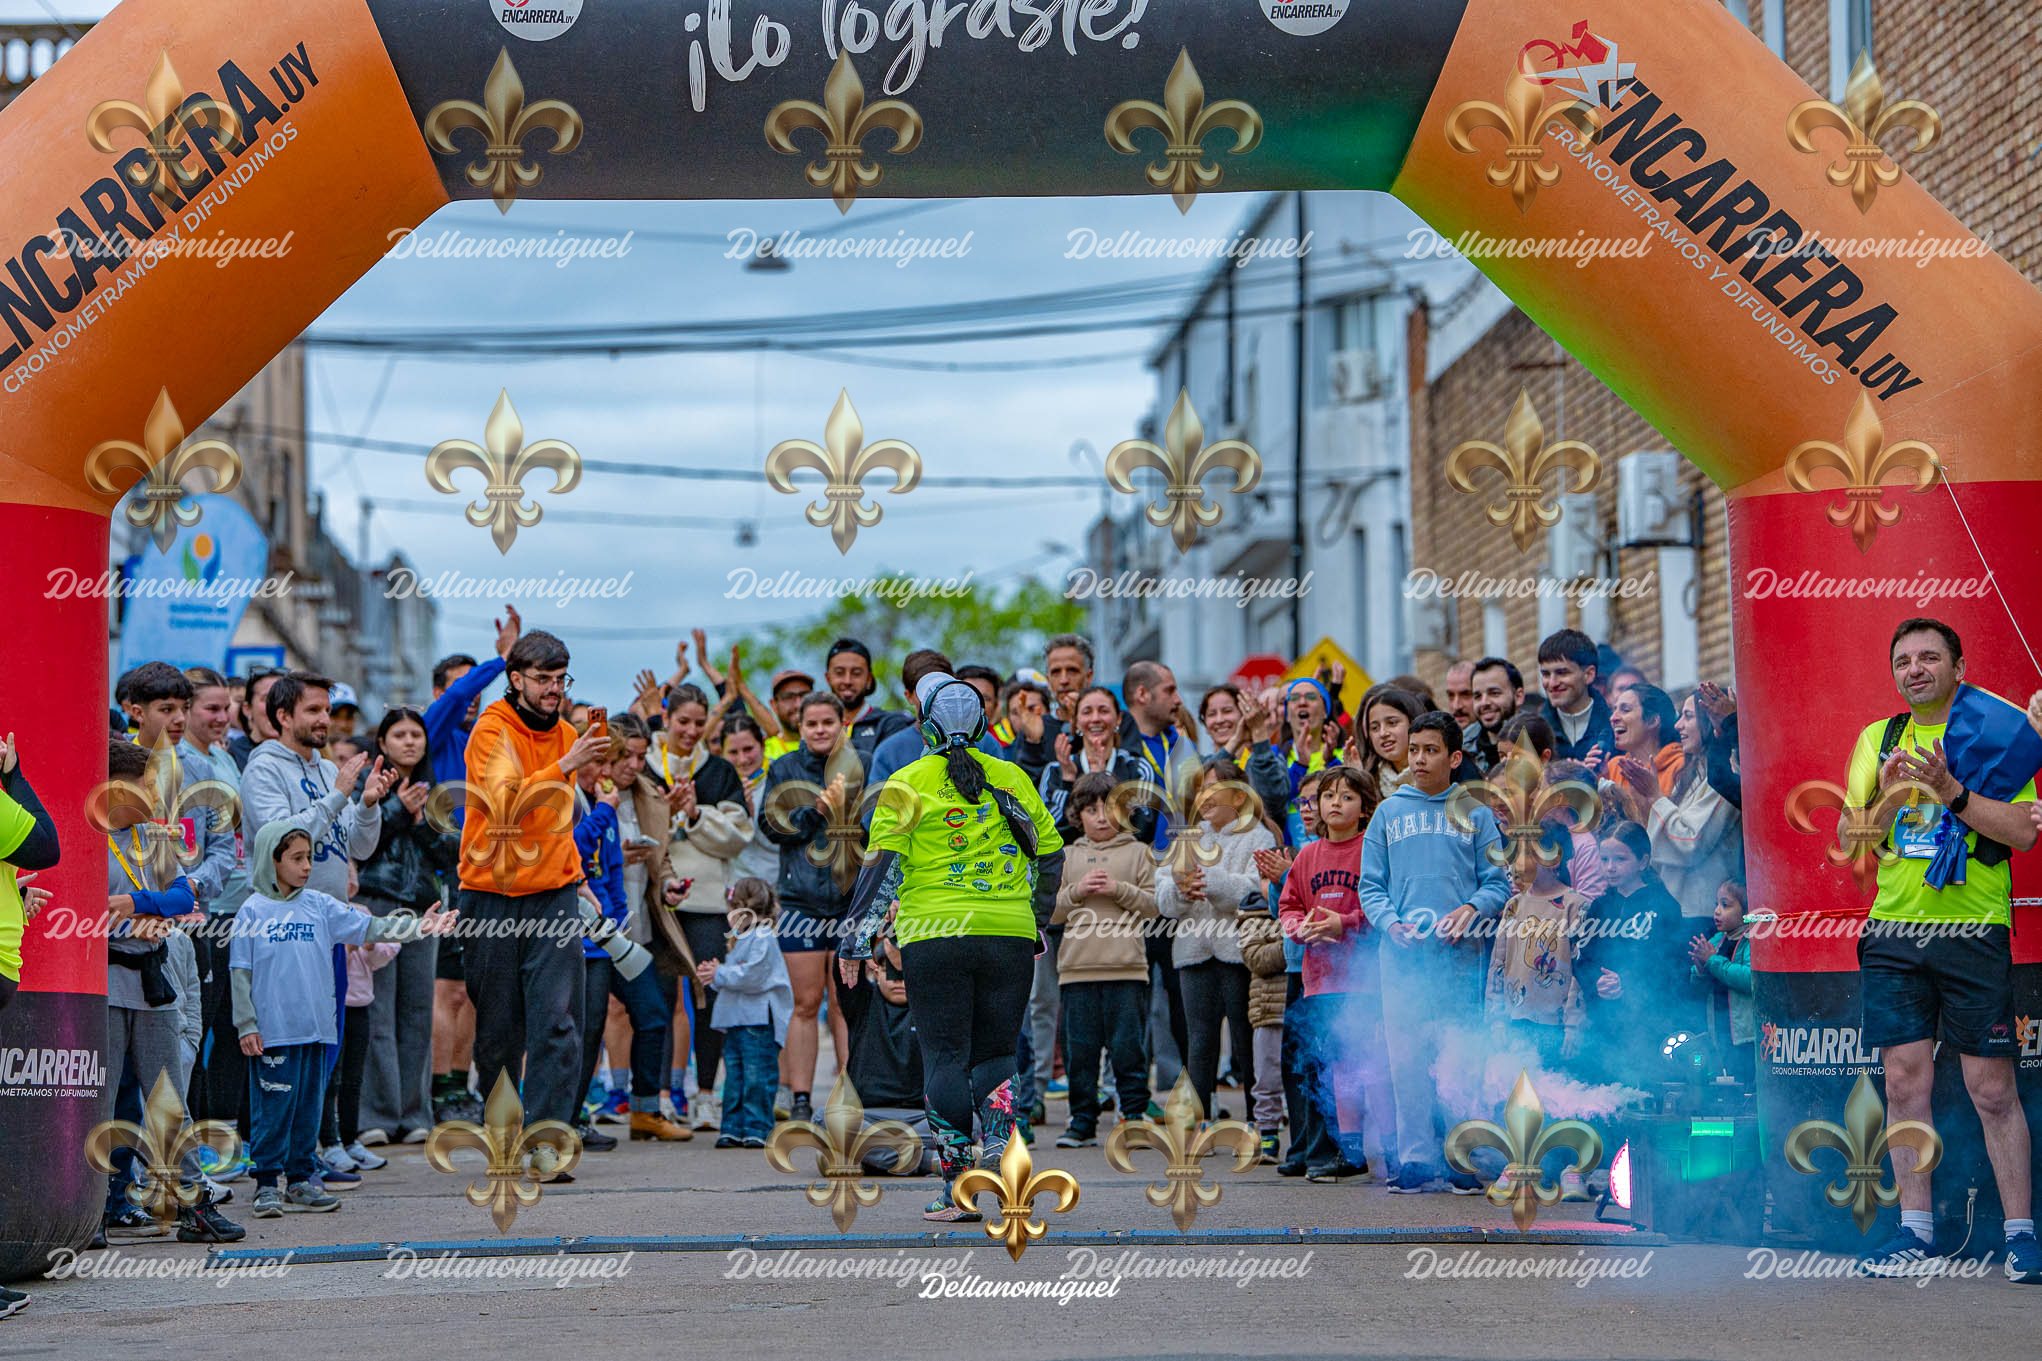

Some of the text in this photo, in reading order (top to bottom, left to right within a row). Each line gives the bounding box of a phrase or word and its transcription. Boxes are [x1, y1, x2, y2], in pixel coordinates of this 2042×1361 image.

[502, 10, 574, 24] ENCARRERA.UY
[1270, 4, 1342, 19] ENCARRERA.UY
[0, 41, 320, 373] NCARRERA.UY
[3, 239, 172, 394] CRONOMETRAMOS
[183, 121, 299, 233] DIFUNDIMOS
[1545, 119, 1841, 386] CRONOMETRAMOS Y DIFUNDIMOS
[1311, 869, 1360, 895] SEATTLE
[1771, 1066, 1837, 1076] CRONOMETRAMOS
[1846, 1066, 1885, 1076] DIFUND
[60, 1089, 98, 1099] DIFUNDIMOS
